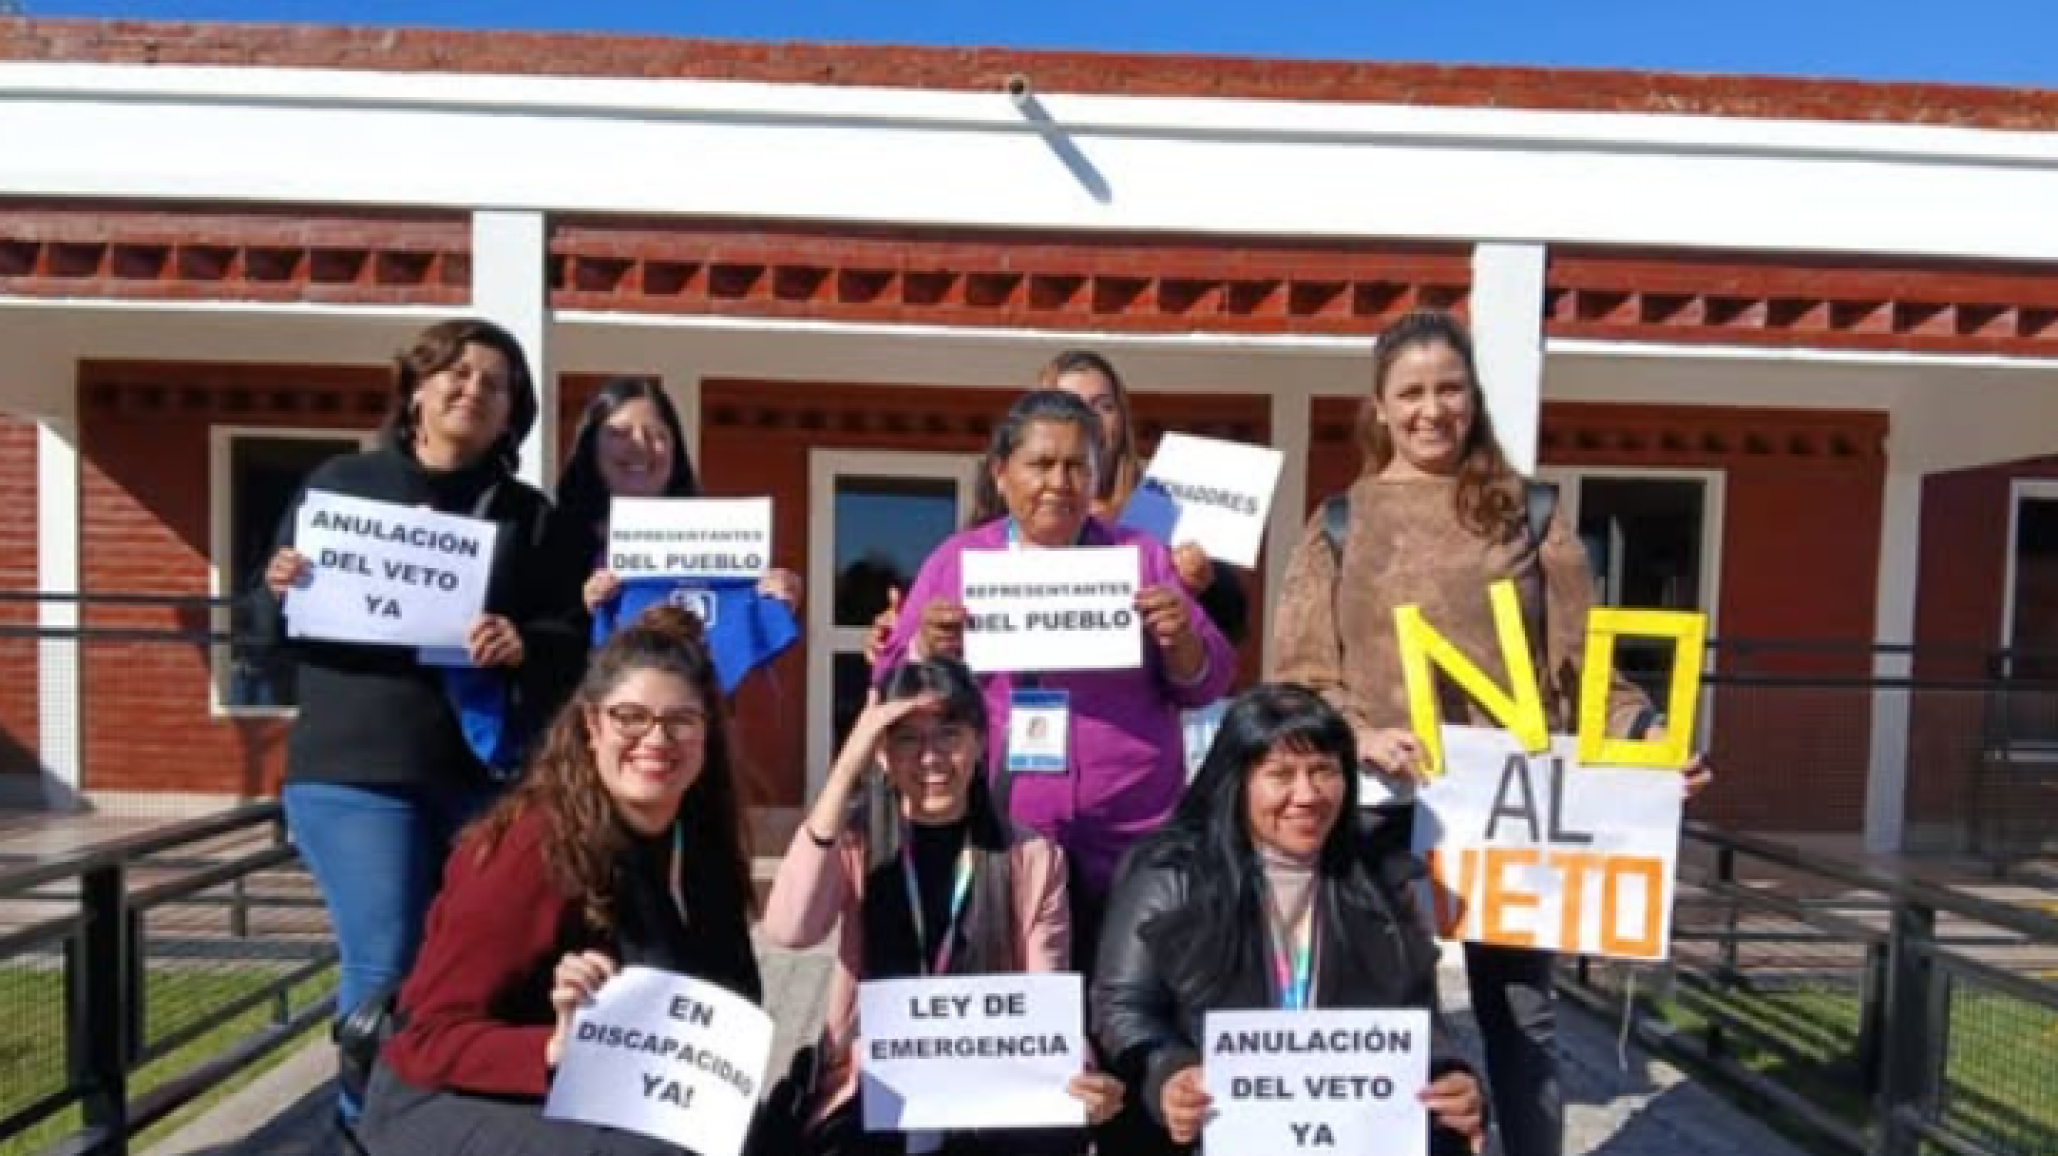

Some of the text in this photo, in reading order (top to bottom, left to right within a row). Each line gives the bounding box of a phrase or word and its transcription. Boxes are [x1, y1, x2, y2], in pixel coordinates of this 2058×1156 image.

[612, 529, 763, 543] REPRESENTANTES
[320, 547, 460, 592] DEL VETO
[612, 552, 762, 571] DEL PUEBLO
[965, 580, 1132, 599] REPRESENTANTES
[365, 593, 402, 620] YA
[965, 608, 1132, 633] DEL PUEBLO
[1394, 578, 1708, 777] NO
[1484, 752, 1594, 844] AL
[1424, 847, 1665, 957] VETO
[669, 993, 715, 1028] EN
[909, 993, 1027, 1019] LEY DE
[870, 1033, 1070, 1061] EMERGENCIA
[1213, 1021, 1413, 1054] ANULACIÓN
[577, 1021, 755, 1097] DISCAPACIDAD
[643, 1072, 695, 1109] YA!
[1231, 1075, 1395, 1101] DEL VETO
[1289, 1121, 1336, 1147] YA
